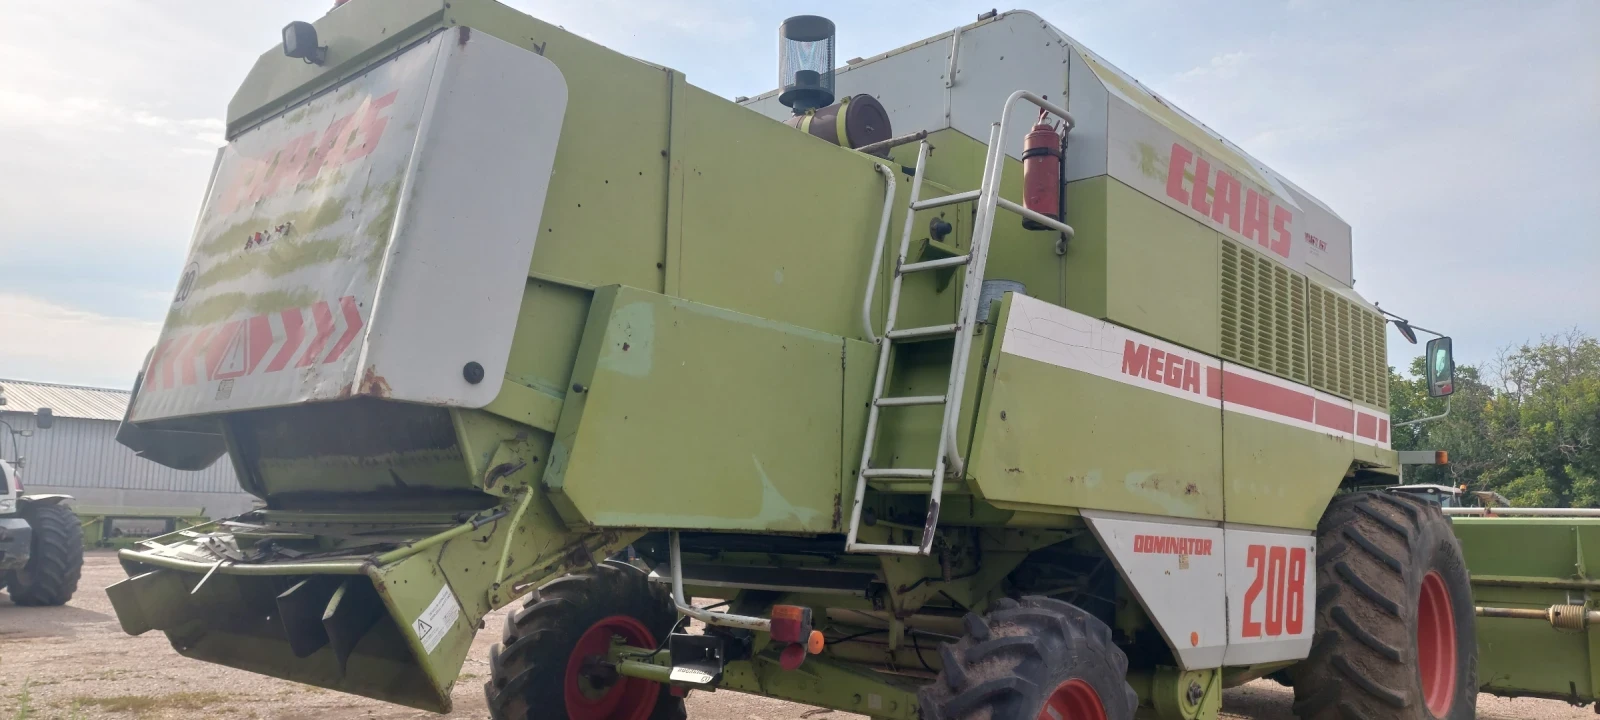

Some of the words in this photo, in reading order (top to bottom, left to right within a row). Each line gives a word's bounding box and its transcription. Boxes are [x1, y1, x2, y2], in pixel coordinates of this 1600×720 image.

[1166, 142, 1292, 258] CLAAS
[174, 269, 196, 303] 20
[1121, 339, 1201, 394] MEGA
[1133, 534, 1213, 556] DOMINATOR
[1241, 544, 1307, 638] 208
